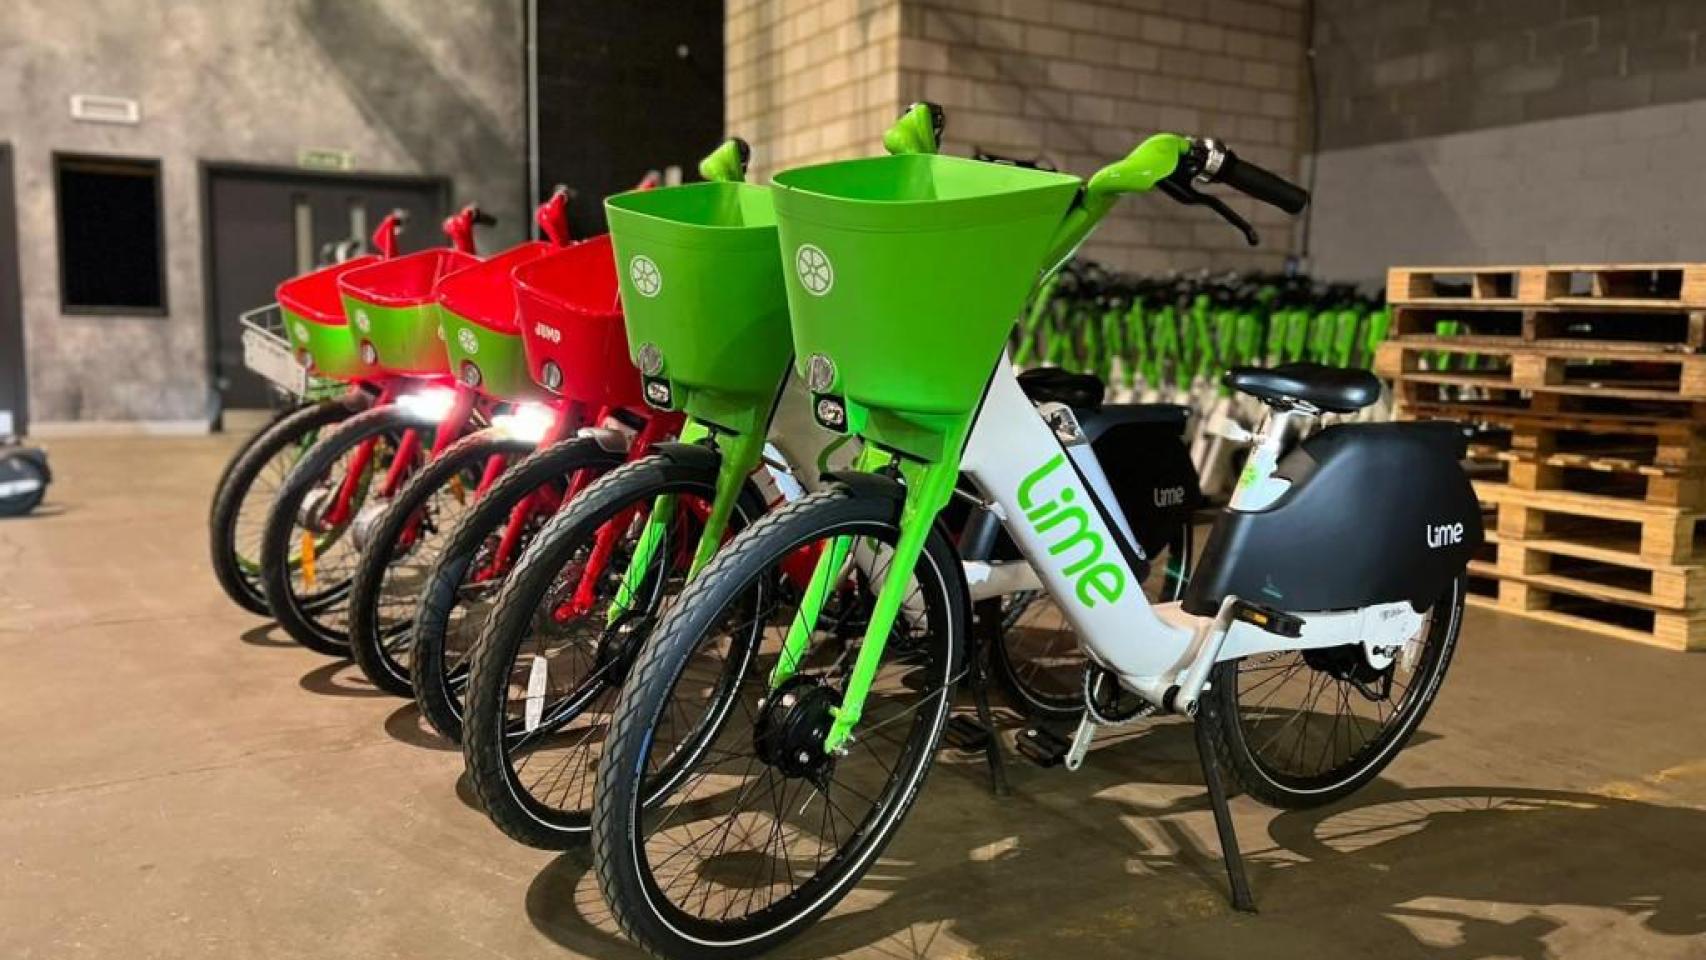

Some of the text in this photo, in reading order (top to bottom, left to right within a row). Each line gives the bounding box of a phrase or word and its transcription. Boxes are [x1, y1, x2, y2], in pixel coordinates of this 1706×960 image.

[535, 322, 561, 344] JUMP
[1154, 486, 1185, 508] Lime
[1017, 453, 1126, 609] Lime
[1427, 522, 1463, 548] Lime
